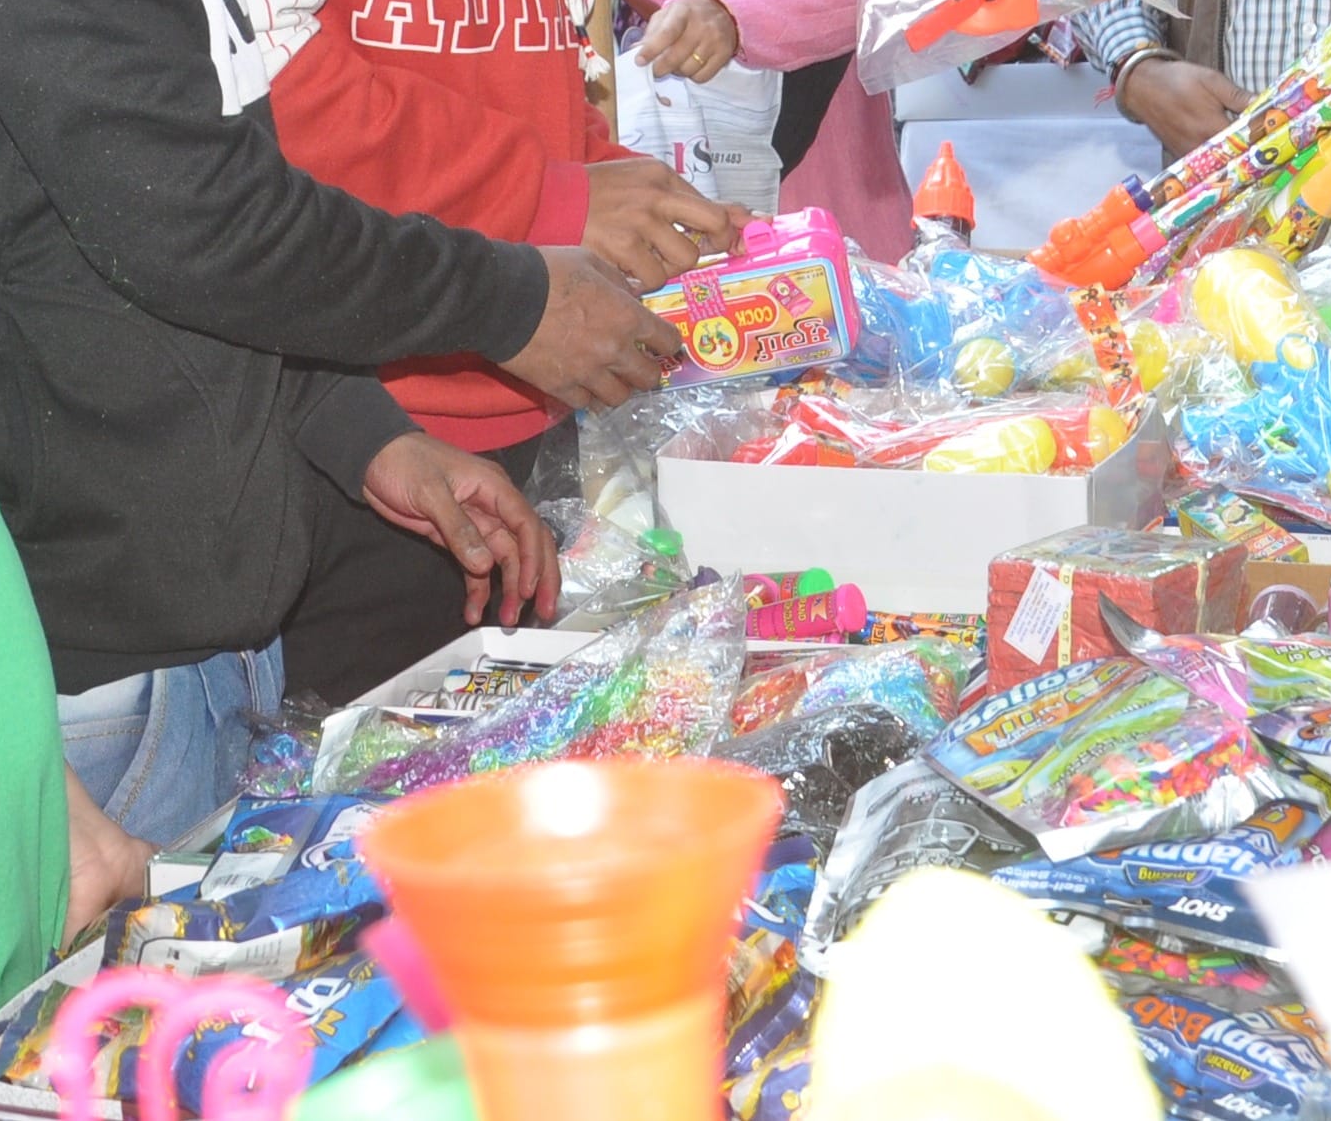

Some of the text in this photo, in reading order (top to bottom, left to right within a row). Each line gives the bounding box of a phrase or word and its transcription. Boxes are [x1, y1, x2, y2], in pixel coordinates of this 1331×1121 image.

[735, 306, 774, 328] COCK
[1138, 867, 1197, 884] Amazing
[1168, 896, 1235, 922] SHOT
[1132, 997, 1213, 1044] Bab
[1203, 1053, 1254, 1082] Amazin
[1213, 1093, 1272, 1120] SHOT
